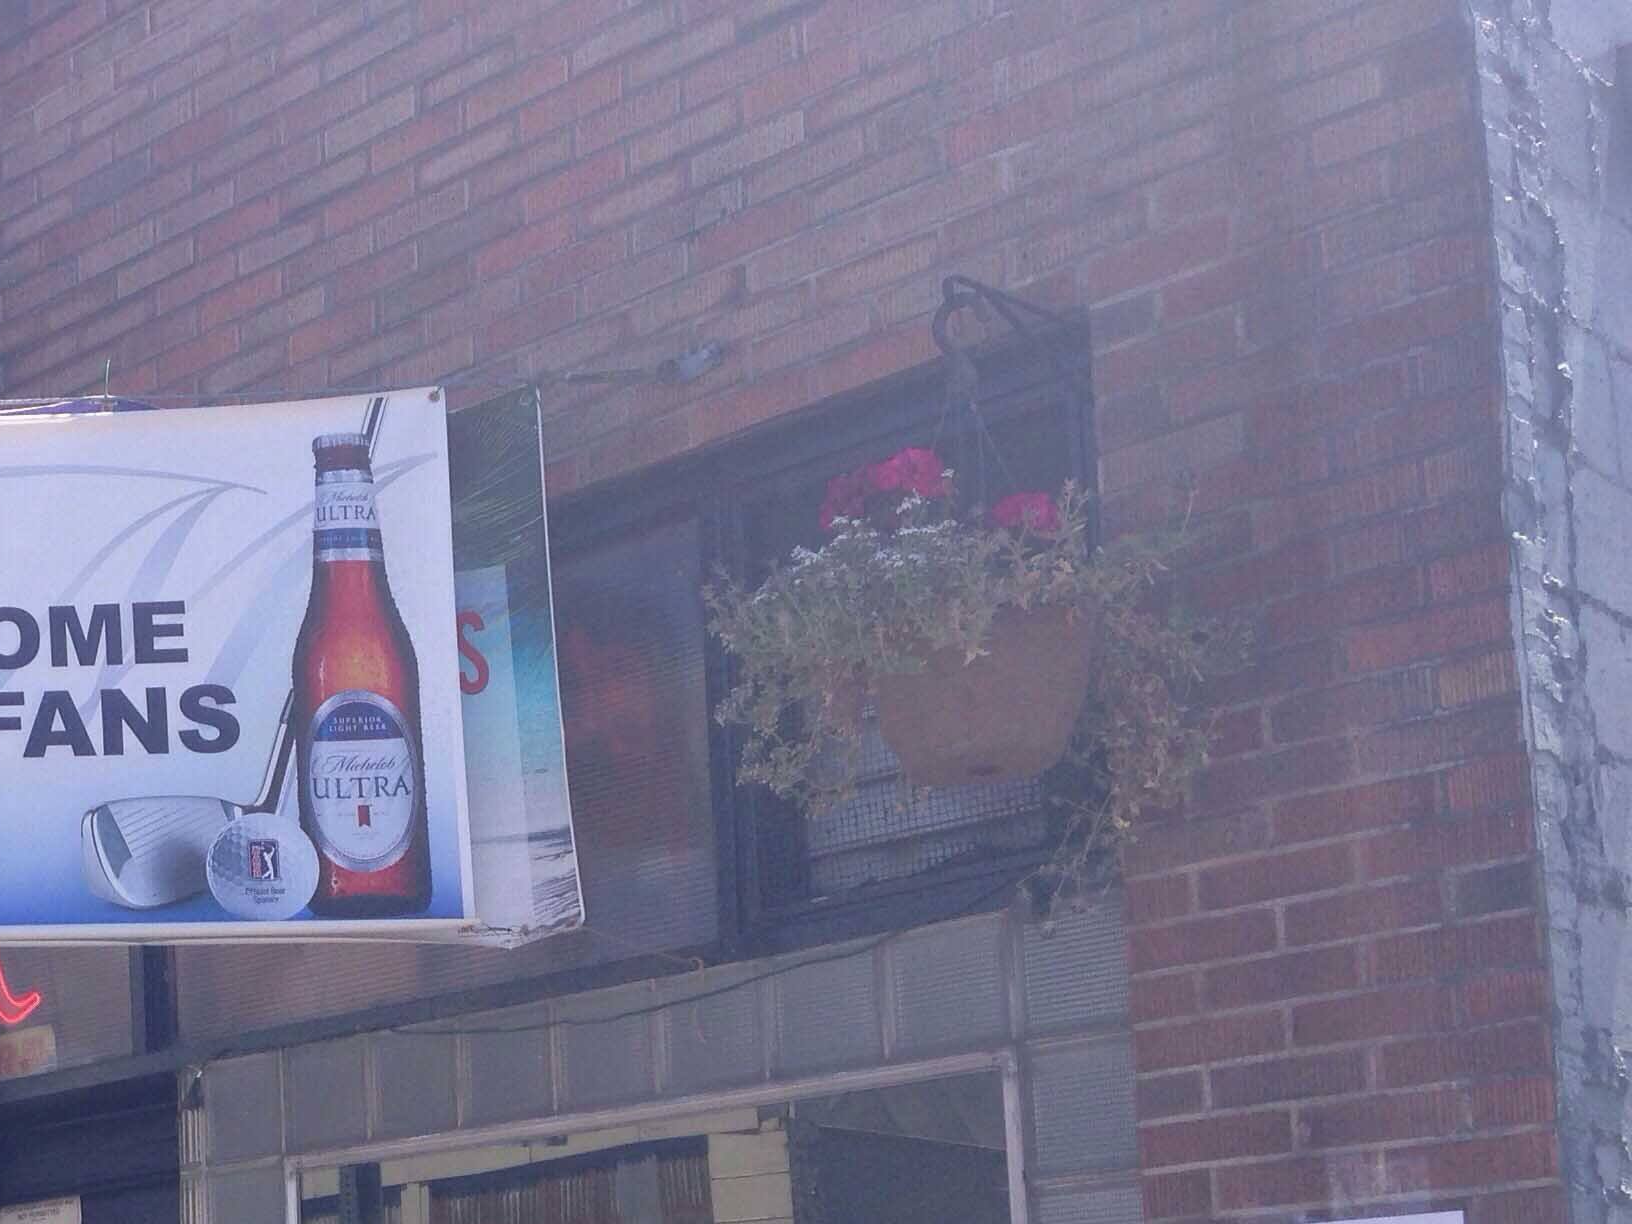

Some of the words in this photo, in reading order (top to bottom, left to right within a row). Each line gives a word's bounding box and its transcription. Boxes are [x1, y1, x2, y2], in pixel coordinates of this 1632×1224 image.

[316, 505, 376, 521] ULTRA
[328, 724, 357, 732] LIGHT
[333, 716, 382, 725] SUPERIOR
[325, 753, 397, 774] Michelob
[312, 775, 412, 799] ULTRA
